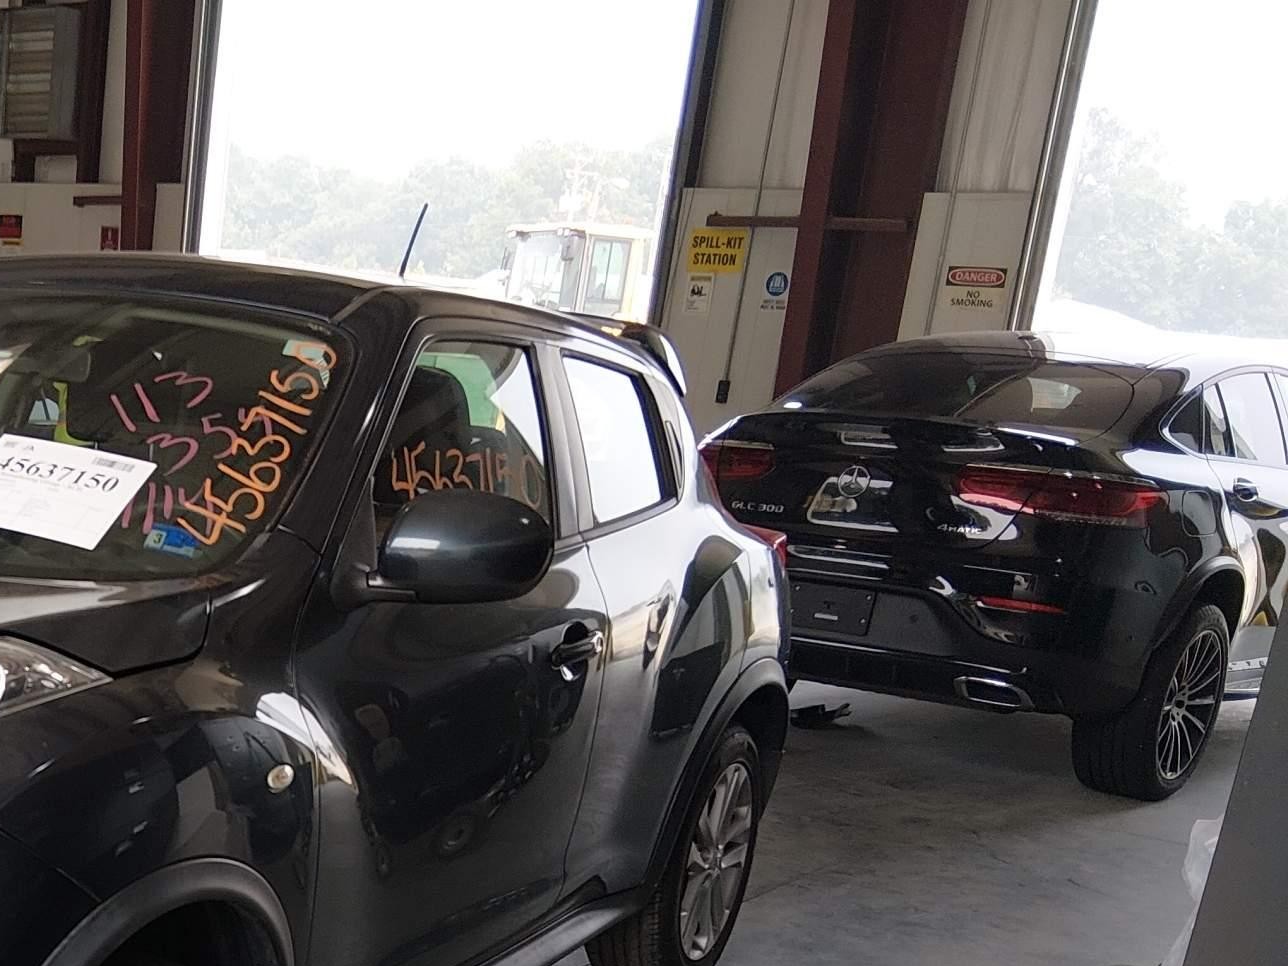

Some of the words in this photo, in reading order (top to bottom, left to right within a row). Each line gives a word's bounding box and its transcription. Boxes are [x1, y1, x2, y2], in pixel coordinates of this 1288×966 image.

[692, 235, 744, 249] SPILL-KIT
[692, 252, 737, 266] STATION
[955, 271, 998, 283] DANGER
[966, 290, 980, 299] NO
[951, 298, 993, 308] SMOKING
[731, 500, 755, 511] GLC
[758, 503, 784, 513] 300
[937, 523, 982, 535] 4MATIC
